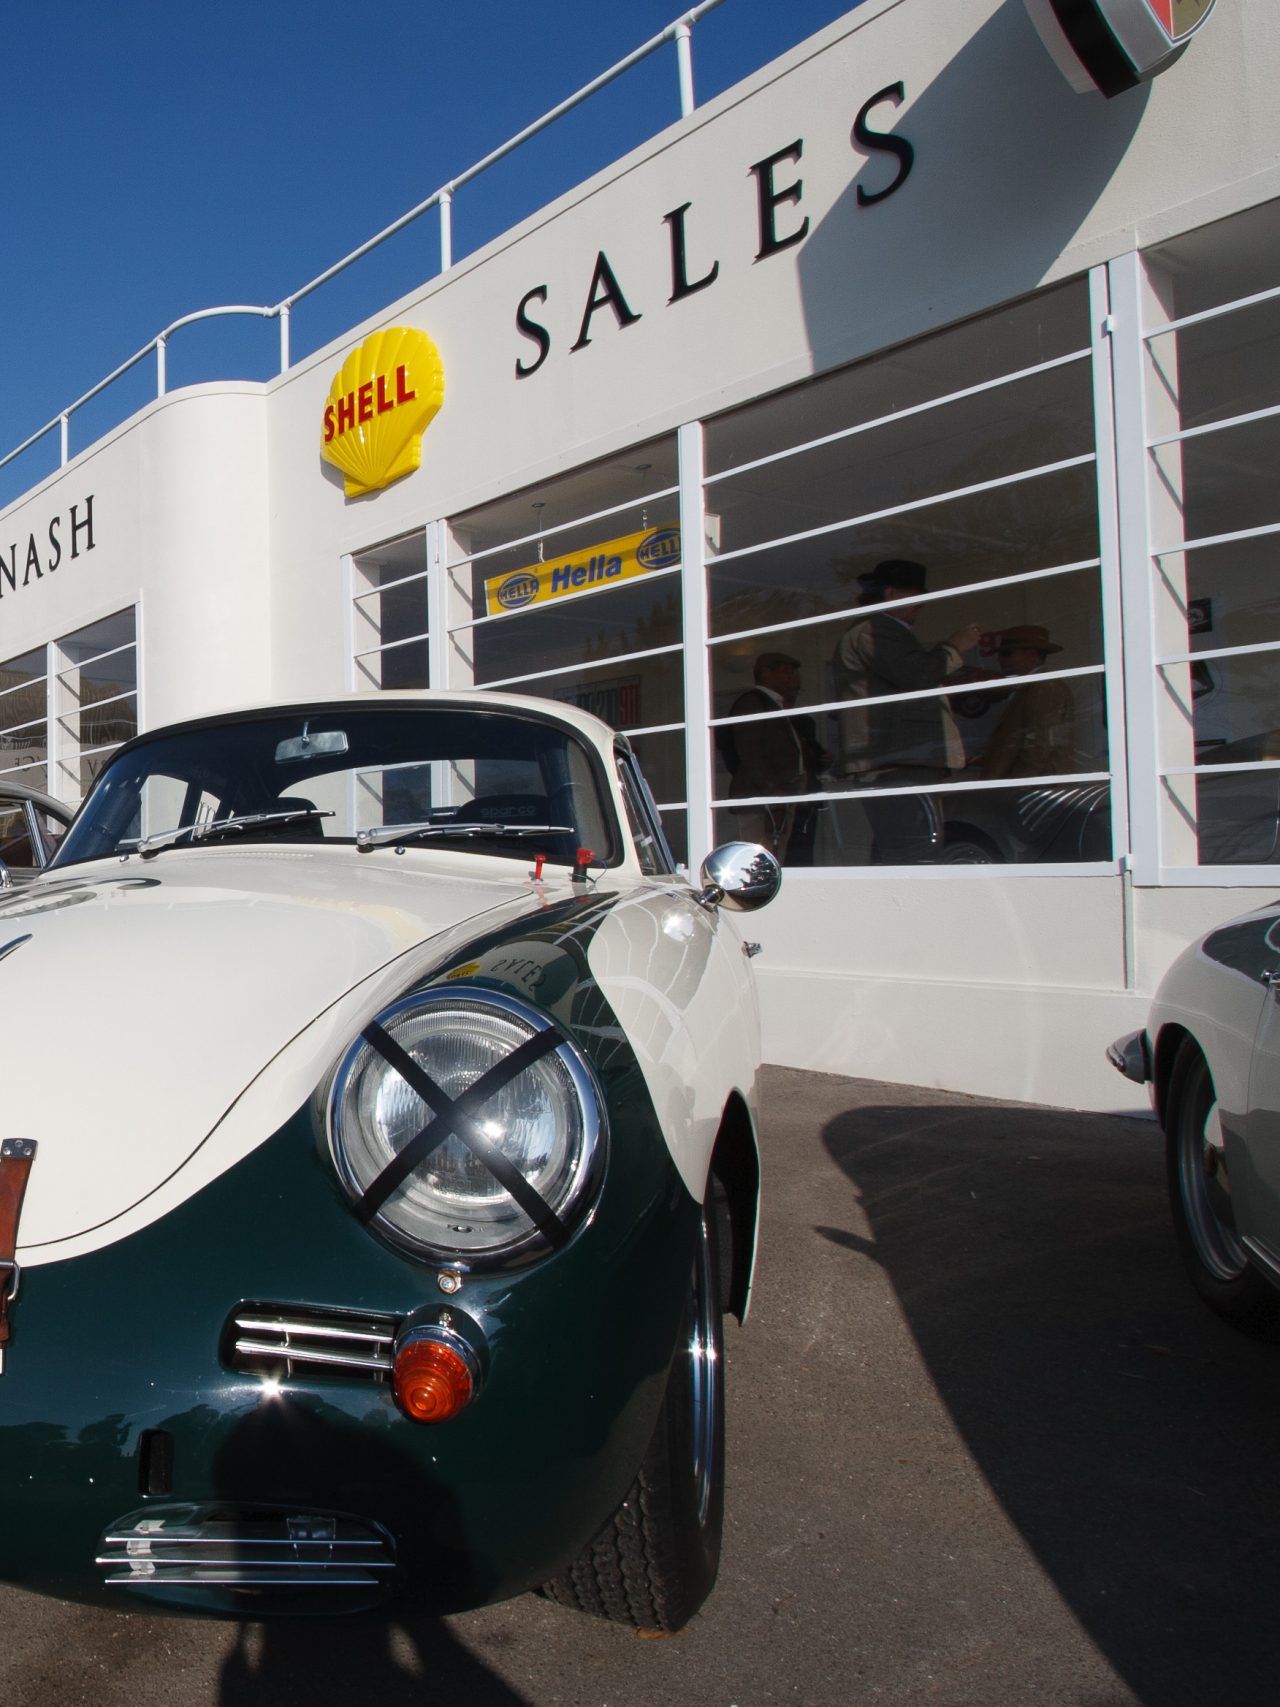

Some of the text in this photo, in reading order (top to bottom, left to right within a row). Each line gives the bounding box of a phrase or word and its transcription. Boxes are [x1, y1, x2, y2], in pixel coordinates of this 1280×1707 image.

[516, 80, 915, 380] SALES
[324, 365, 415, 444] SHELL
[500, 533, 682, 601] HELLA Hella HELL
[480, 805, 537, 818] sparco
